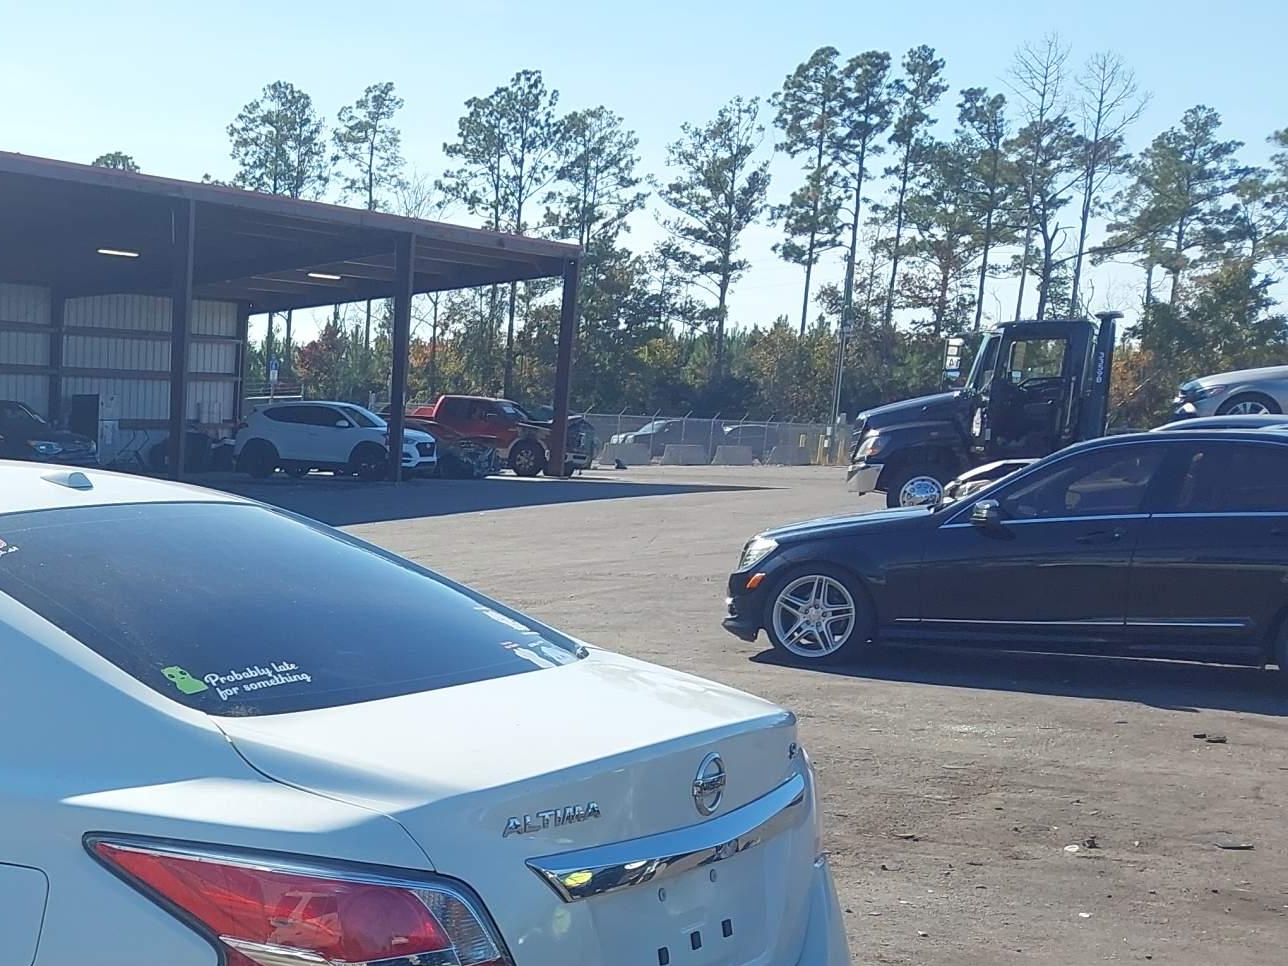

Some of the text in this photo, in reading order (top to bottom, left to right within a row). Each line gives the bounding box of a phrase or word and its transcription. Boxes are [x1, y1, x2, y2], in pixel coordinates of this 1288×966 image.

[204, 661, 299, 687] Probably late
[216, 672, 312, 701] for something
[502, 801, 601, 838] ALTIMA
